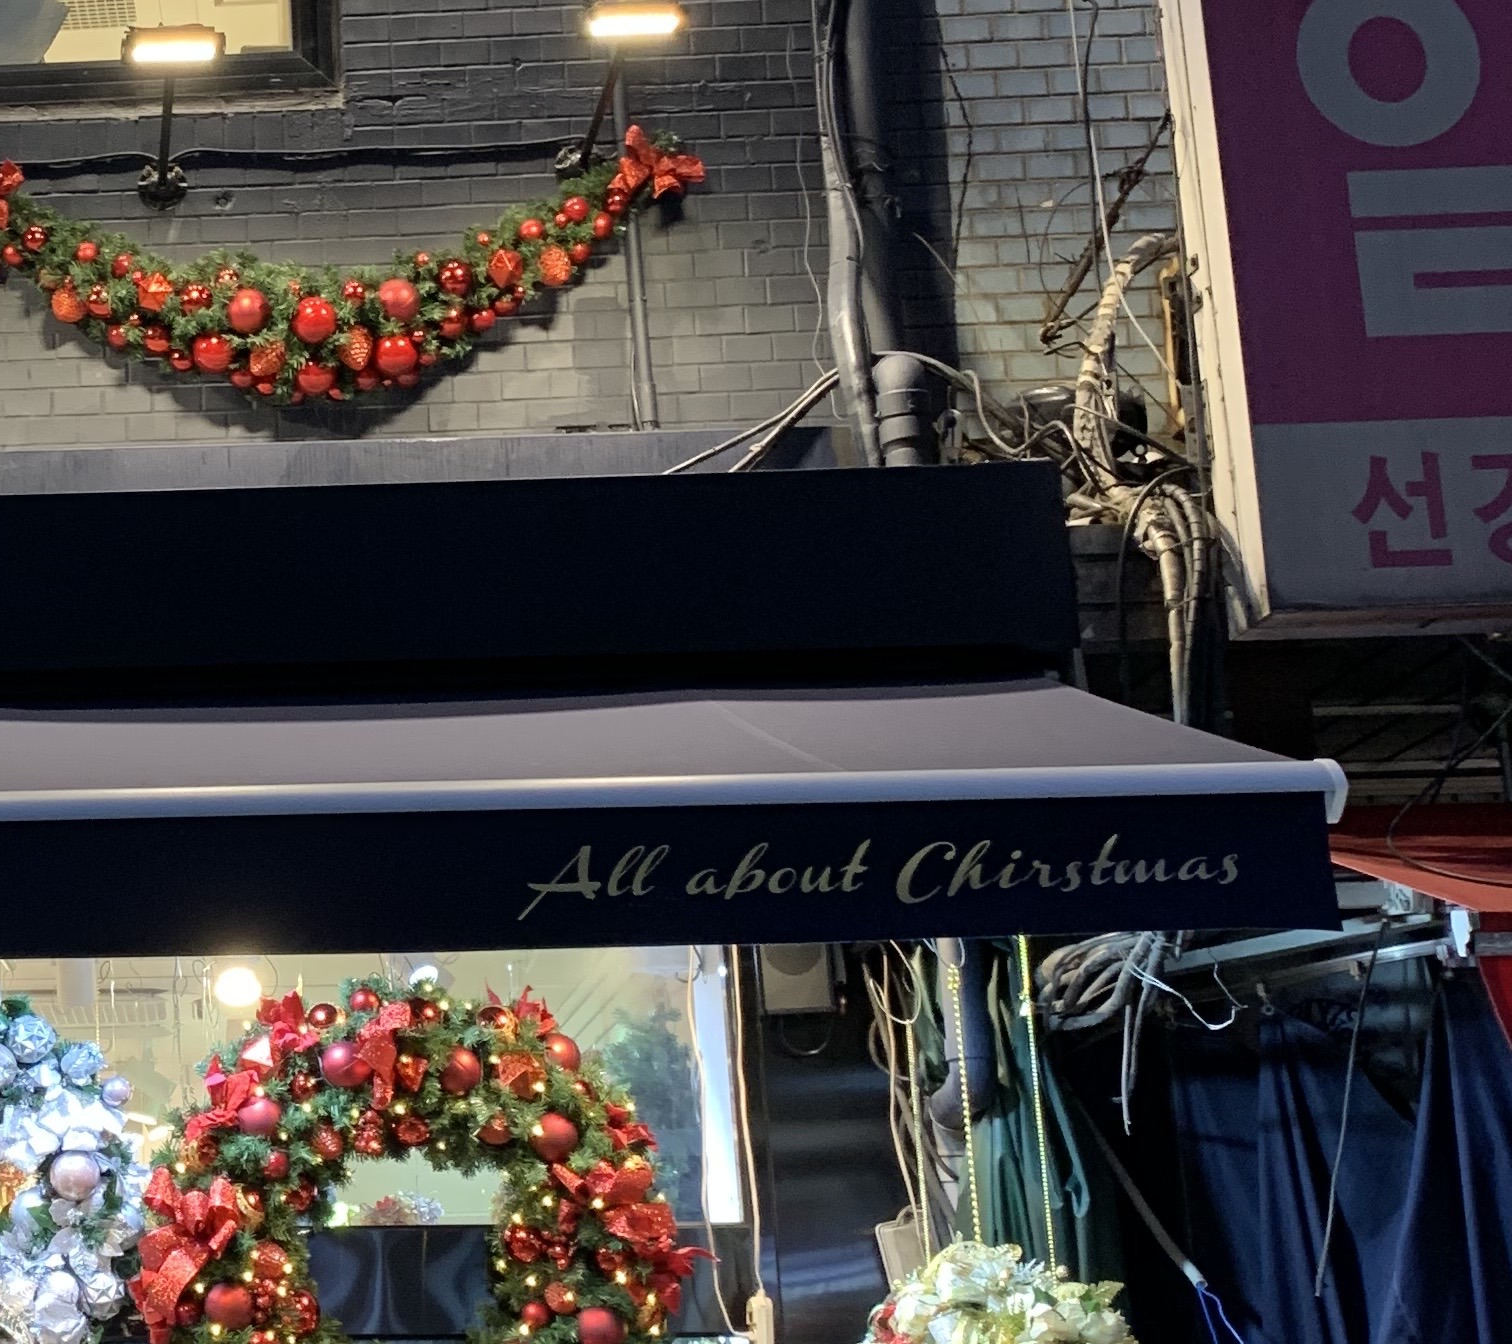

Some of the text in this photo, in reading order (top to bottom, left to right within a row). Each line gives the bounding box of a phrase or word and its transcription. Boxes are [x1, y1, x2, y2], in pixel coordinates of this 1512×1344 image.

[517, 833, 1239, 921] All about Chirstmas
